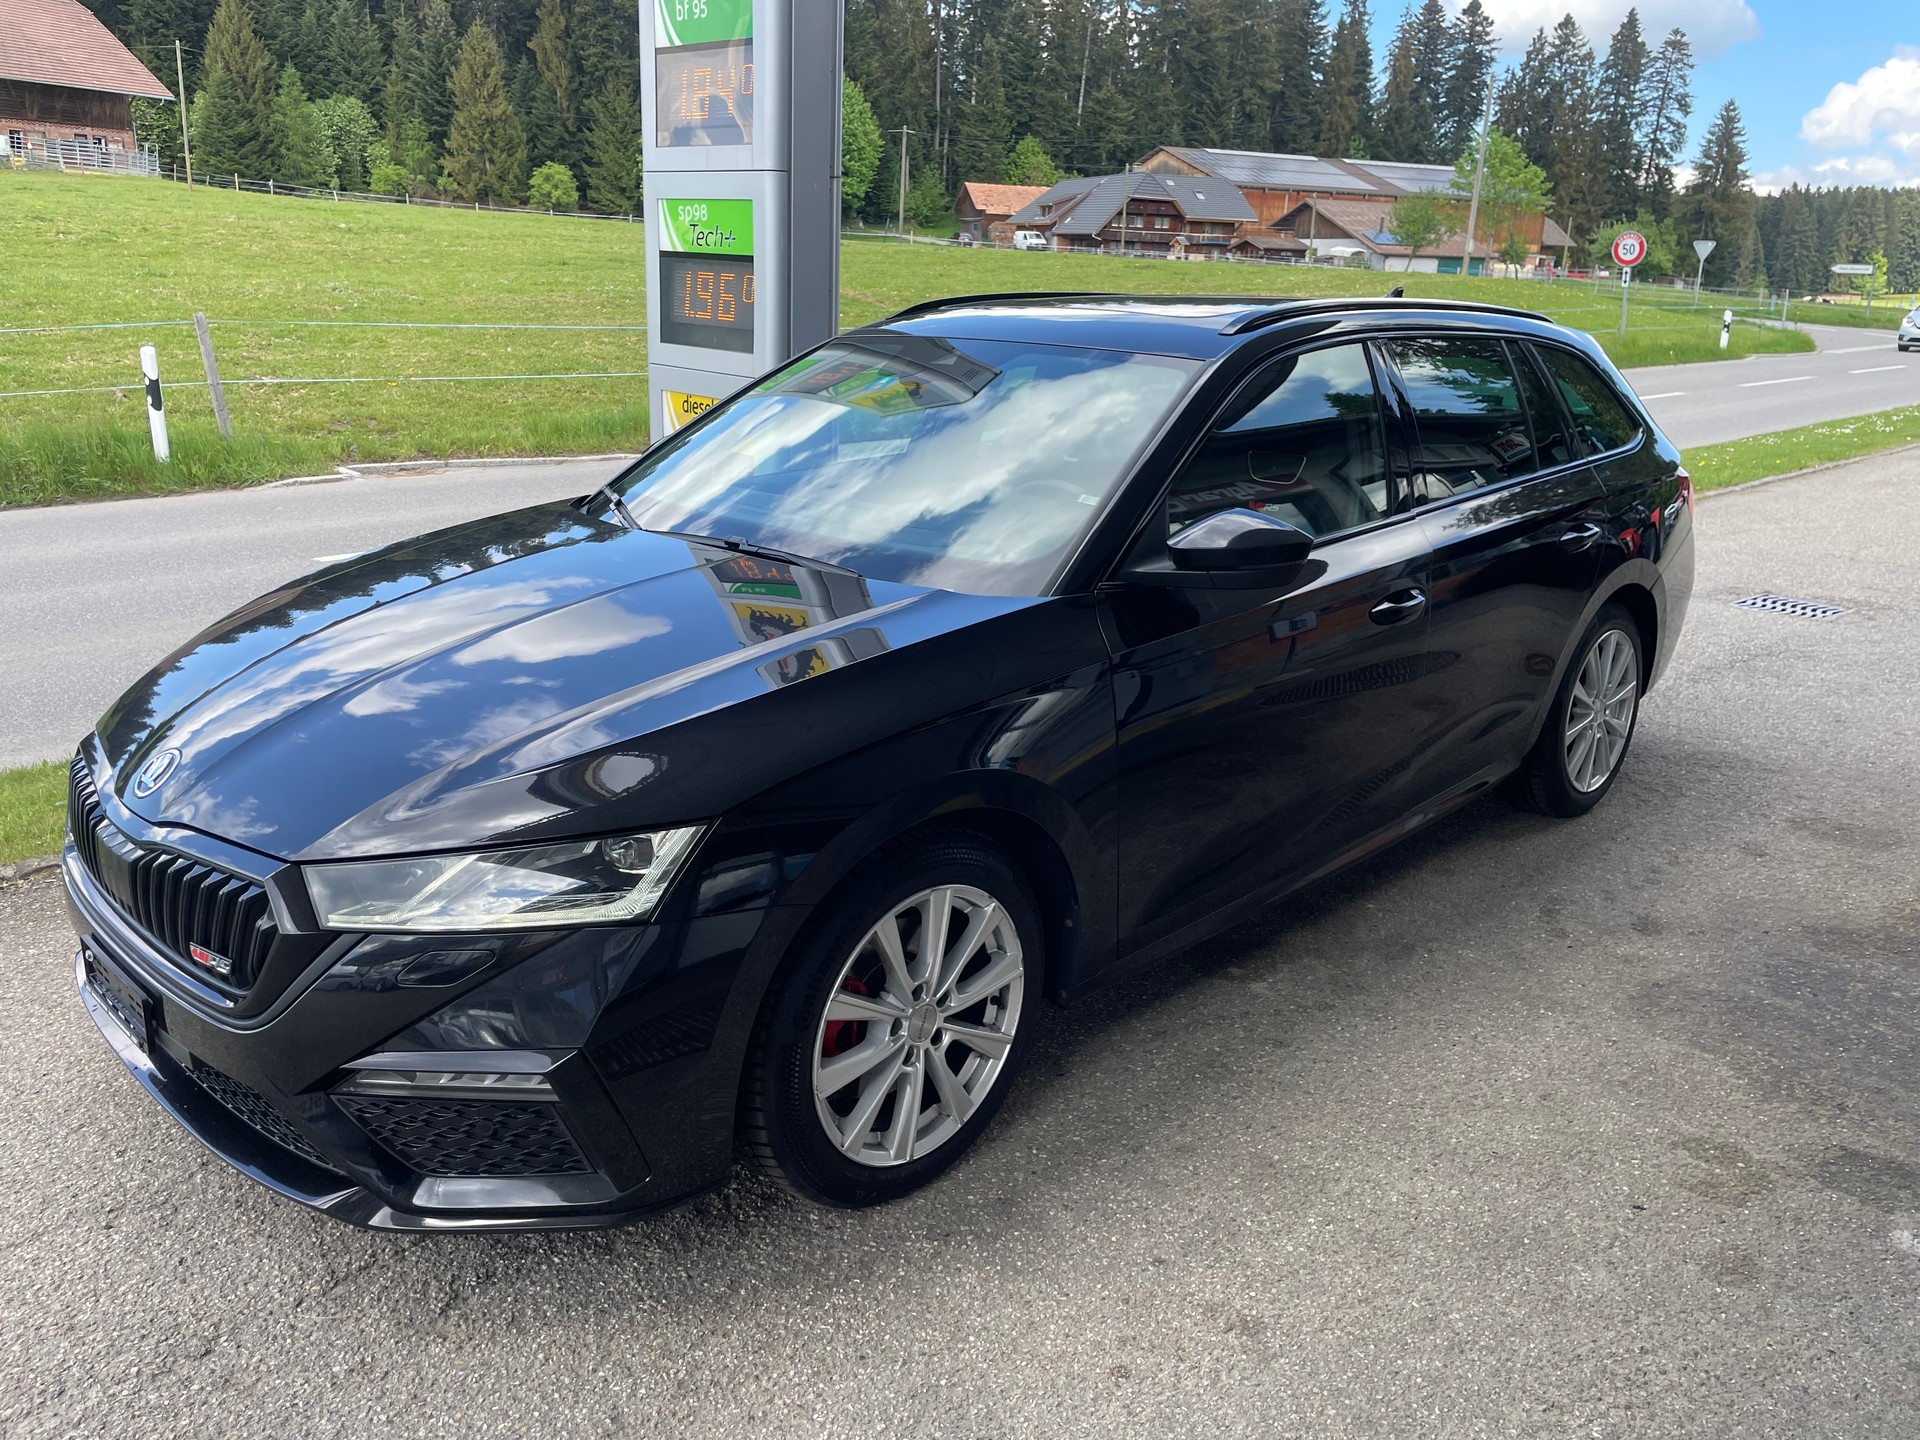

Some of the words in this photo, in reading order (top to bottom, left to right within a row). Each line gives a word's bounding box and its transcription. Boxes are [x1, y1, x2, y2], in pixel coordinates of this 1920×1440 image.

[675, 0, 689, 21] bf
[692, 0, 708, 19] 95
[677, 204, 708, 225] sp98
[689, 224, 736, 248] Tech+
[1622, 244, 1636, 255] 50
